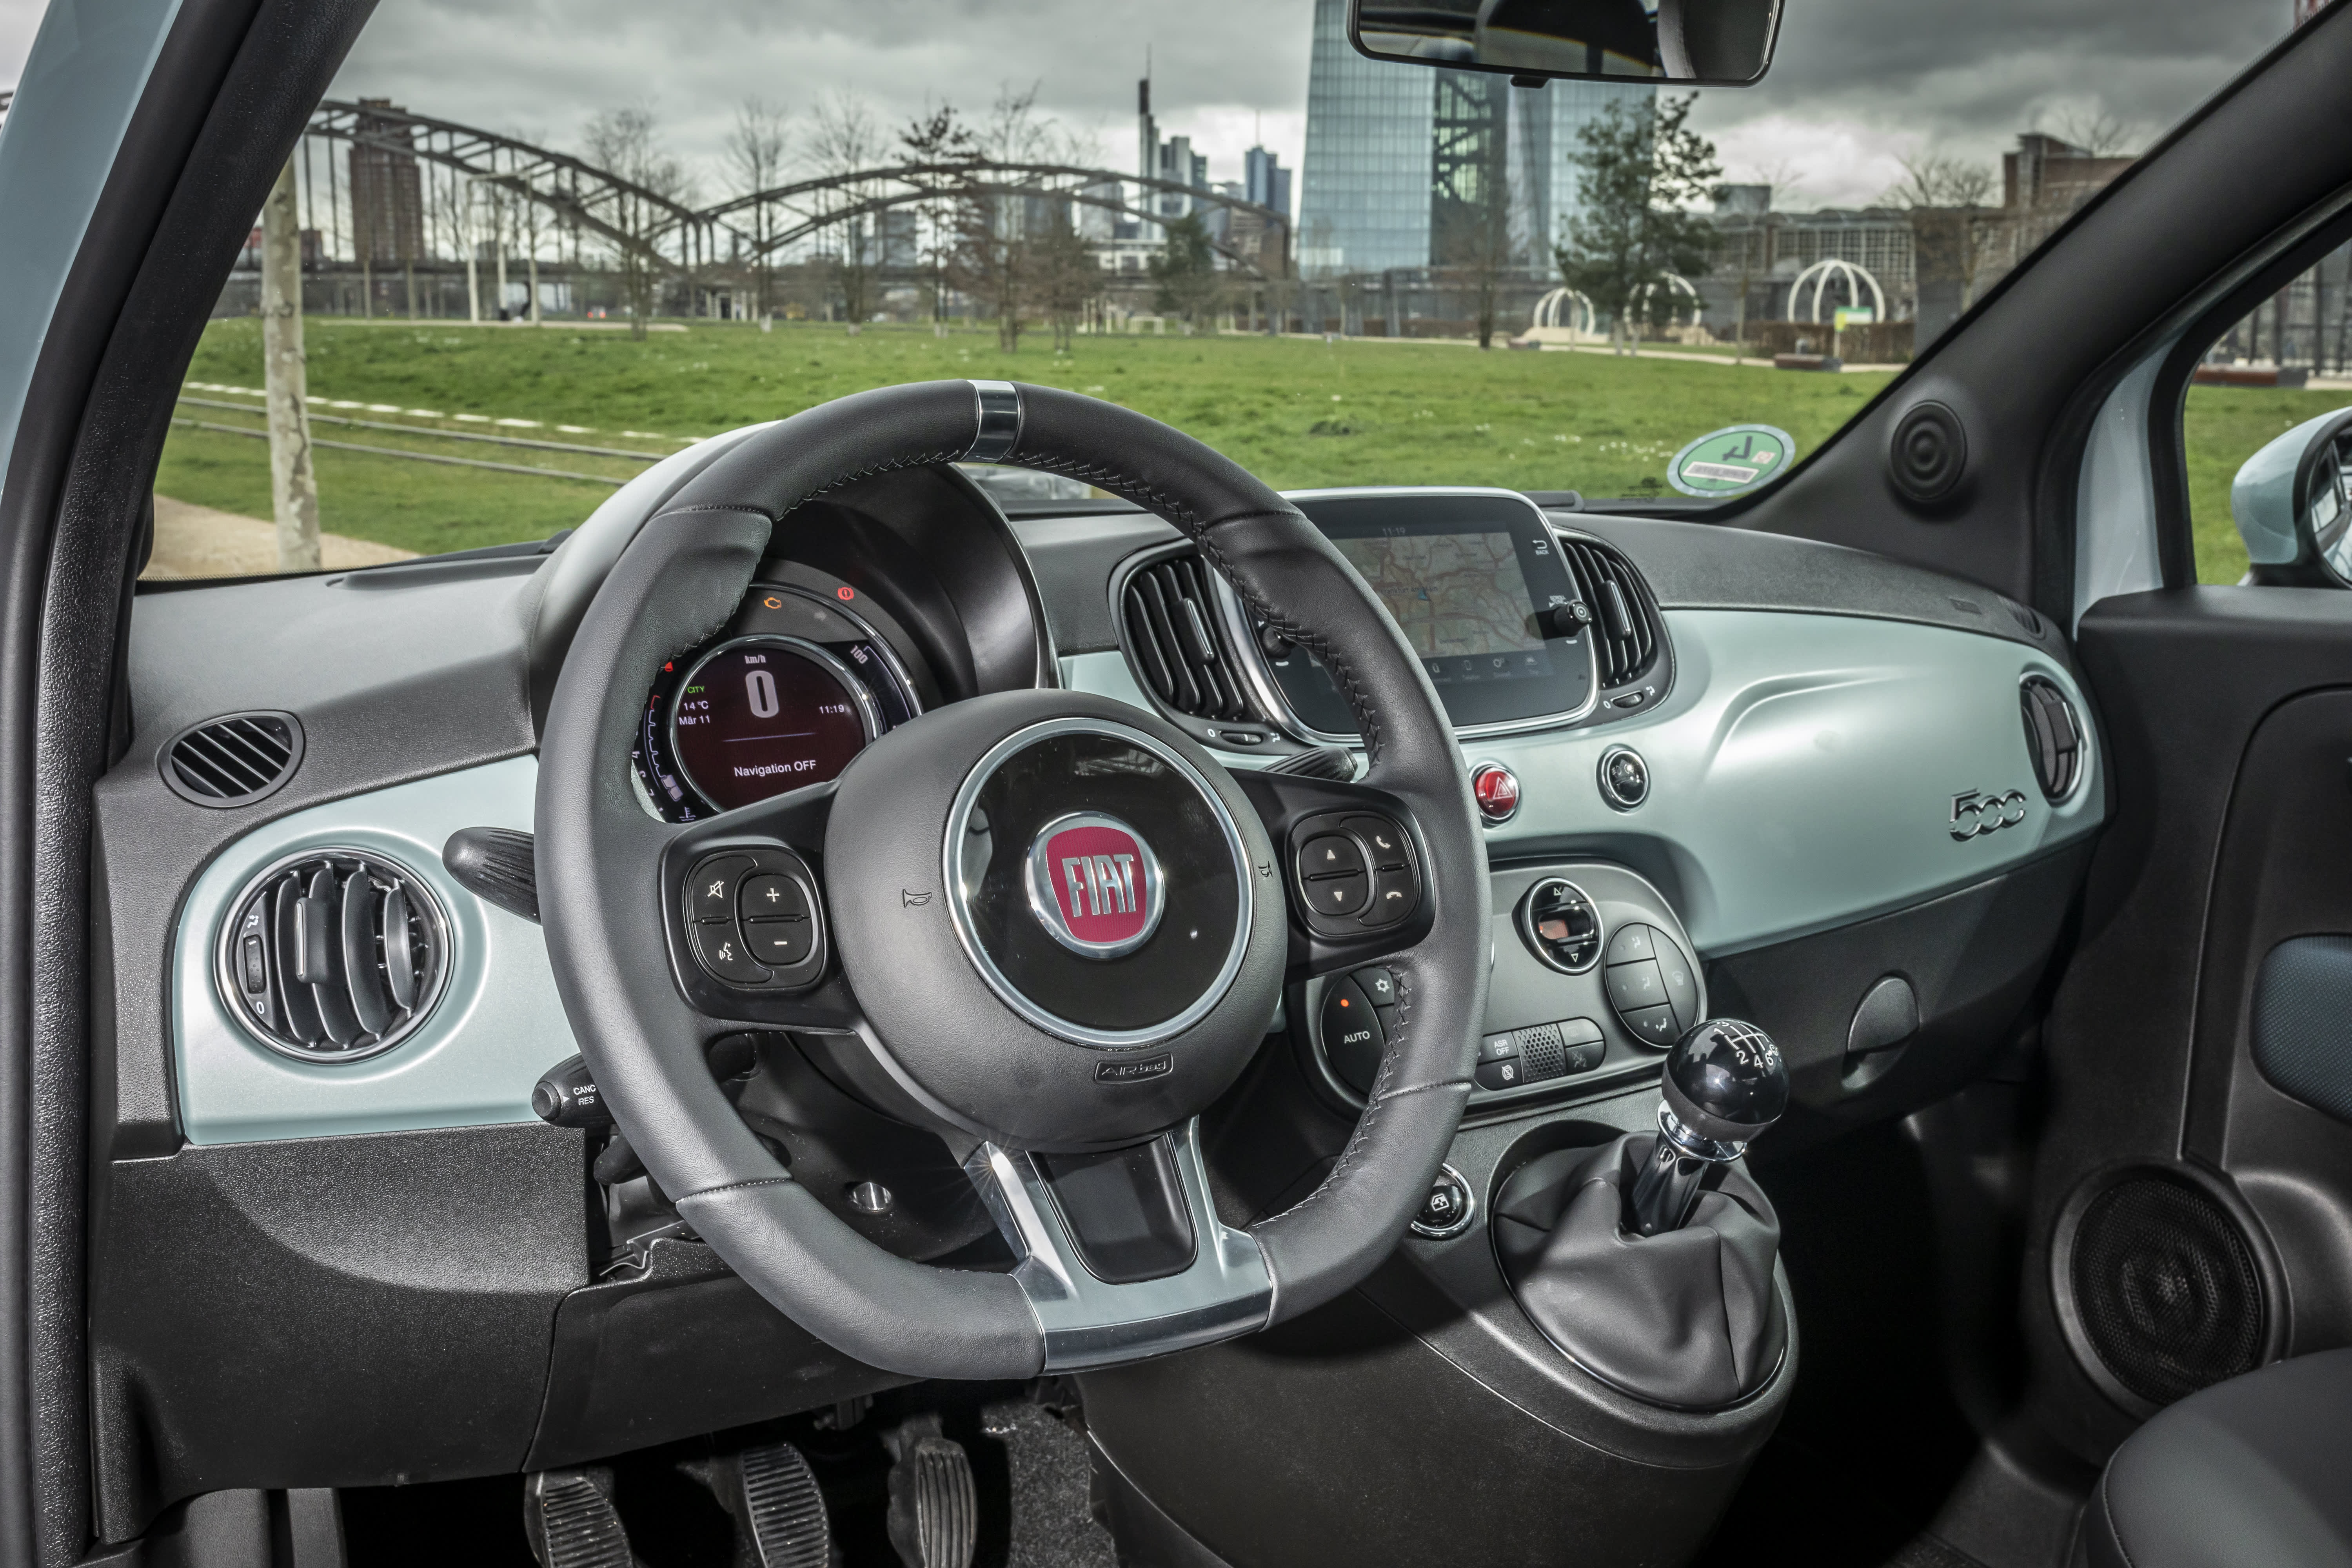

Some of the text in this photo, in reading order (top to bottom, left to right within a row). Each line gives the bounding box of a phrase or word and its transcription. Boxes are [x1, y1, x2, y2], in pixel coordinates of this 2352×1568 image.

[745, 654, 766, 664] km/h
[850, 645, 868, 664] 100
[746, 670, 779, 718] 0
[684, 702, 696, 710] 14
[819, 705, 845, 714] 11:19
[679, 715, 710, 725] Mär 11
[734, 760, 816, 777] Navigation OFF
[1949, 788, 2027, 842] 500
[1062, 854, 1136, 918] FIAT
[1344, 1030, 1370, 1044] AUTO
[1494, 1039, 1508, 1048] ASR
[1496, 1047, 1509, 1056] OFF
[1736, 1050, 1749, 1065] 2
[1754, 1054, 1763, 1069] 4
[1765, 1052, 1774, 1066] 6
[573, 1084, 596, 1095] CANC
[578, 1096, 594, 1106] RES
